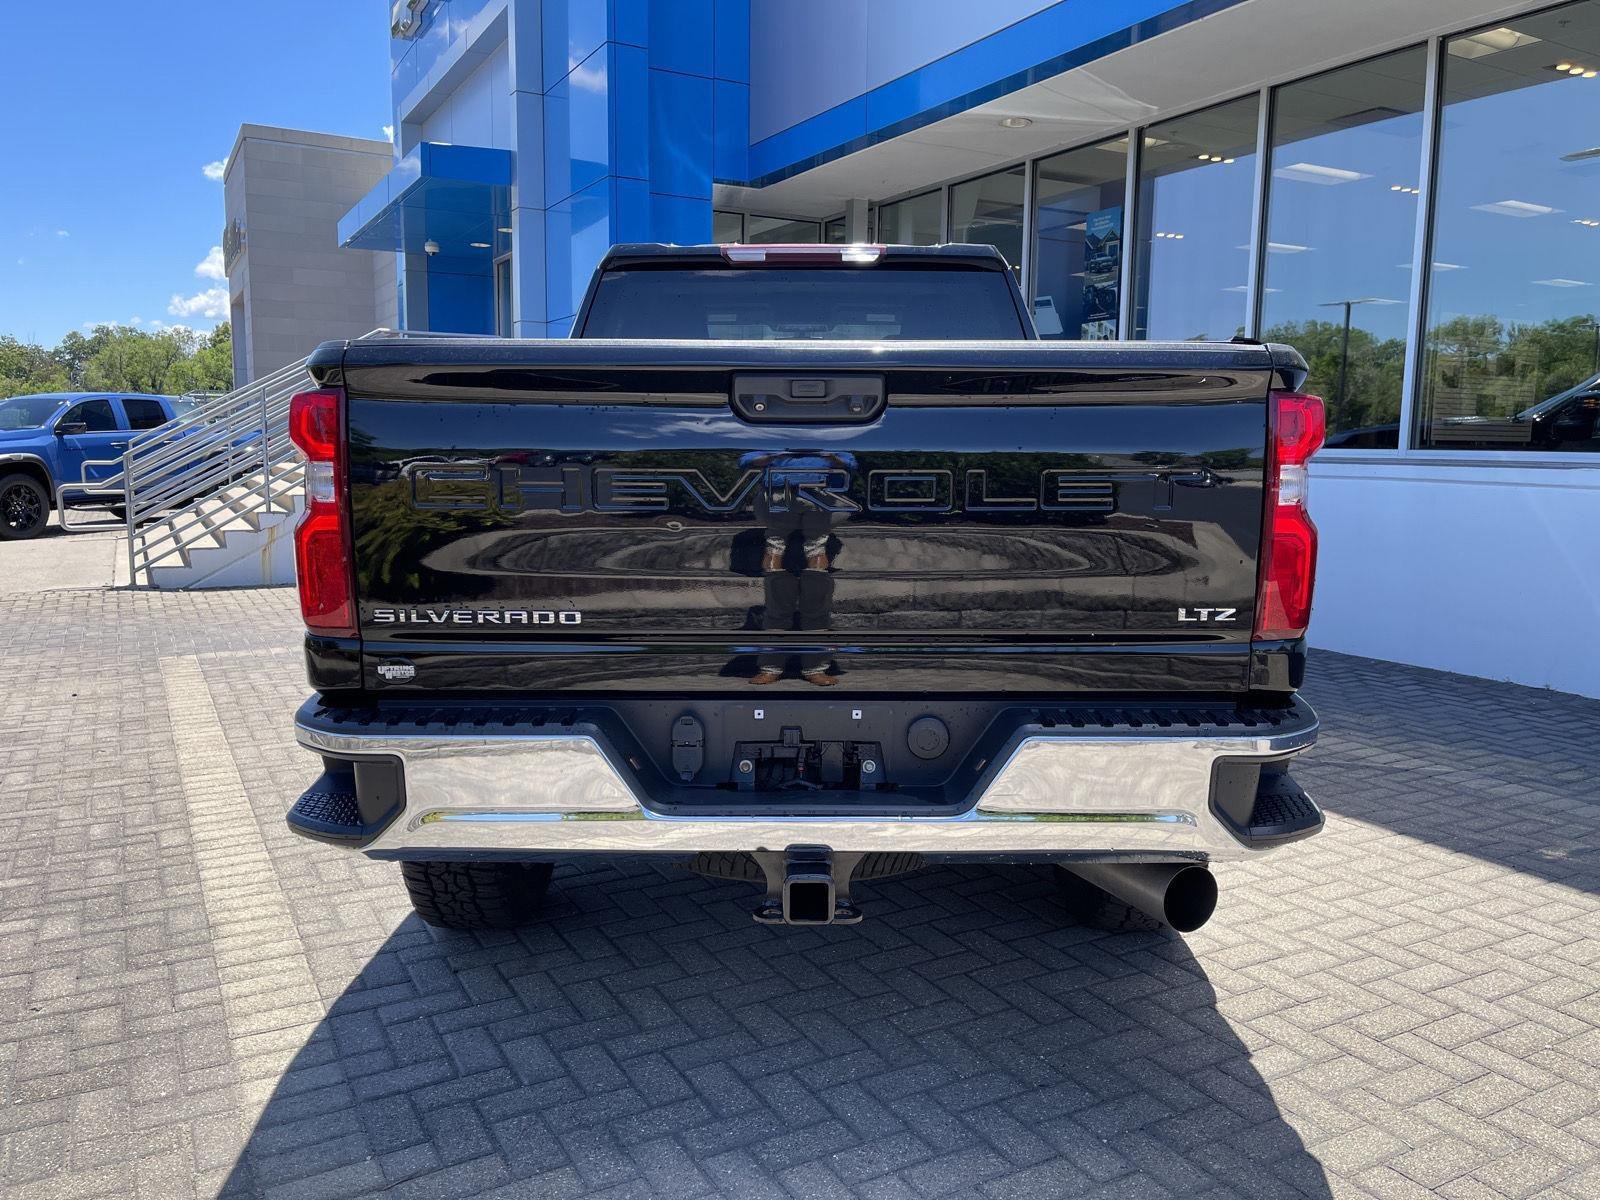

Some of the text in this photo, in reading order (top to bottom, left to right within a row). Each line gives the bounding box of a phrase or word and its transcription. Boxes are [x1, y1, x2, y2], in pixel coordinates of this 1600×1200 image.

[409, 464, 1208, 511] CHEVROLET
[373, 609, 582, 624] SILVERADO
[1177, 607, 1237, 622] LTZ
